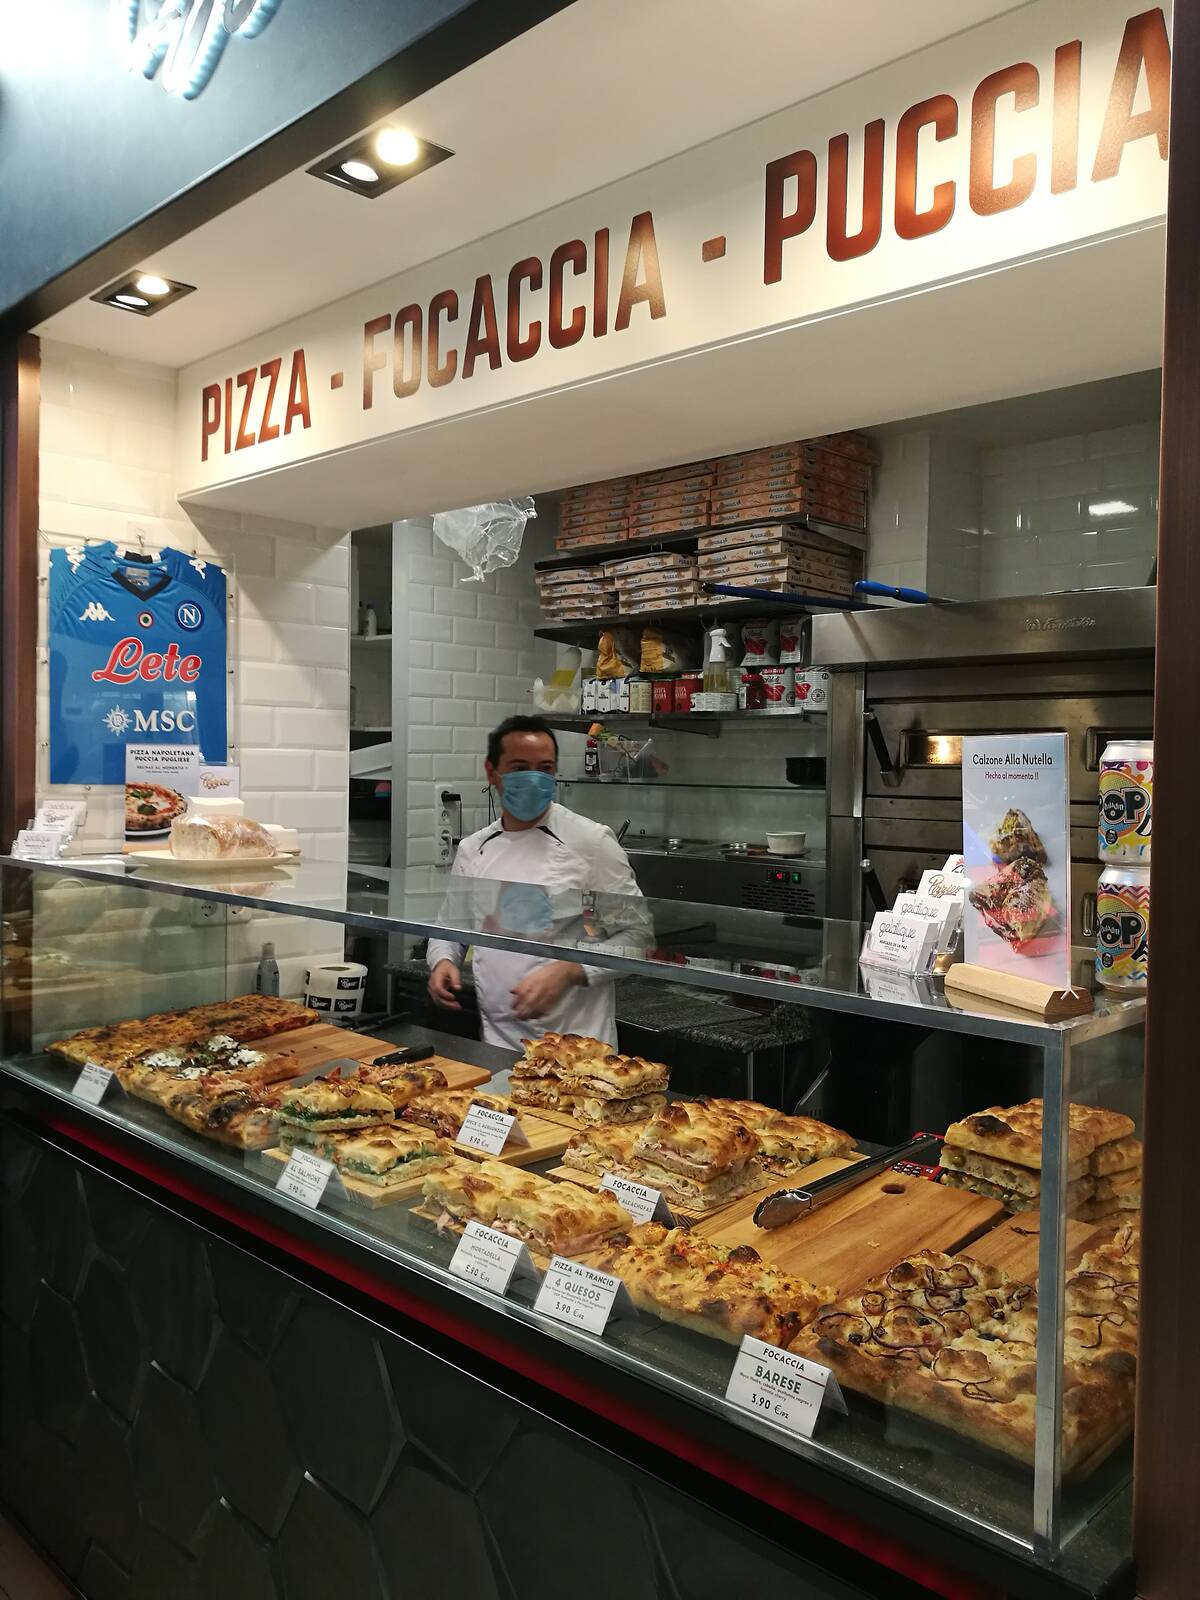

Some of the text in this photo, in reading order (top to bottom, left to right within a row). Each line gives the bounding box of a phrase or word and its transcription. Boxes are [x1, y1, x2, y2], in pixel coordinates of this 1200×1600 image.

[201, 348, 311, 461] PIZZA
[363, 210, 667, 410] FOCACCIA
[764, 7, 1171, 286] PUCCIA
[91, 636, 202, 685] Lete
[133, 709, 196, 732] MSC
[972, 752, 1053, 766] Calzone Alla Nutella
[984, 771, 1001, 780] Hecho
[1001, 771, 1008, 780] al
[1008, 772, 1034, 780] momento
[1099, 787, 1151, 824] OP
[1097, 912, 1147, 949] OP
[478, 1109, 504, 1122] FOCACCIA
[612, 1180, 647, 1198] FOCACCIA
[475, 1228, 510, 1249] FOCACCIA
[471, 1244, 501, 1261] MORTADELLA
[554, 1260, 614, 1287] PIZZA AL TRANCIO
[555, 1278, 561, 1288] 4
[564, 1281, 601, 1302] QUESOS
[763, 1347, 806, 1372] FOCACCIA
[754, 1365, 802, 1395] BARESE
[751, 1392, 771, 1410] 3.90
